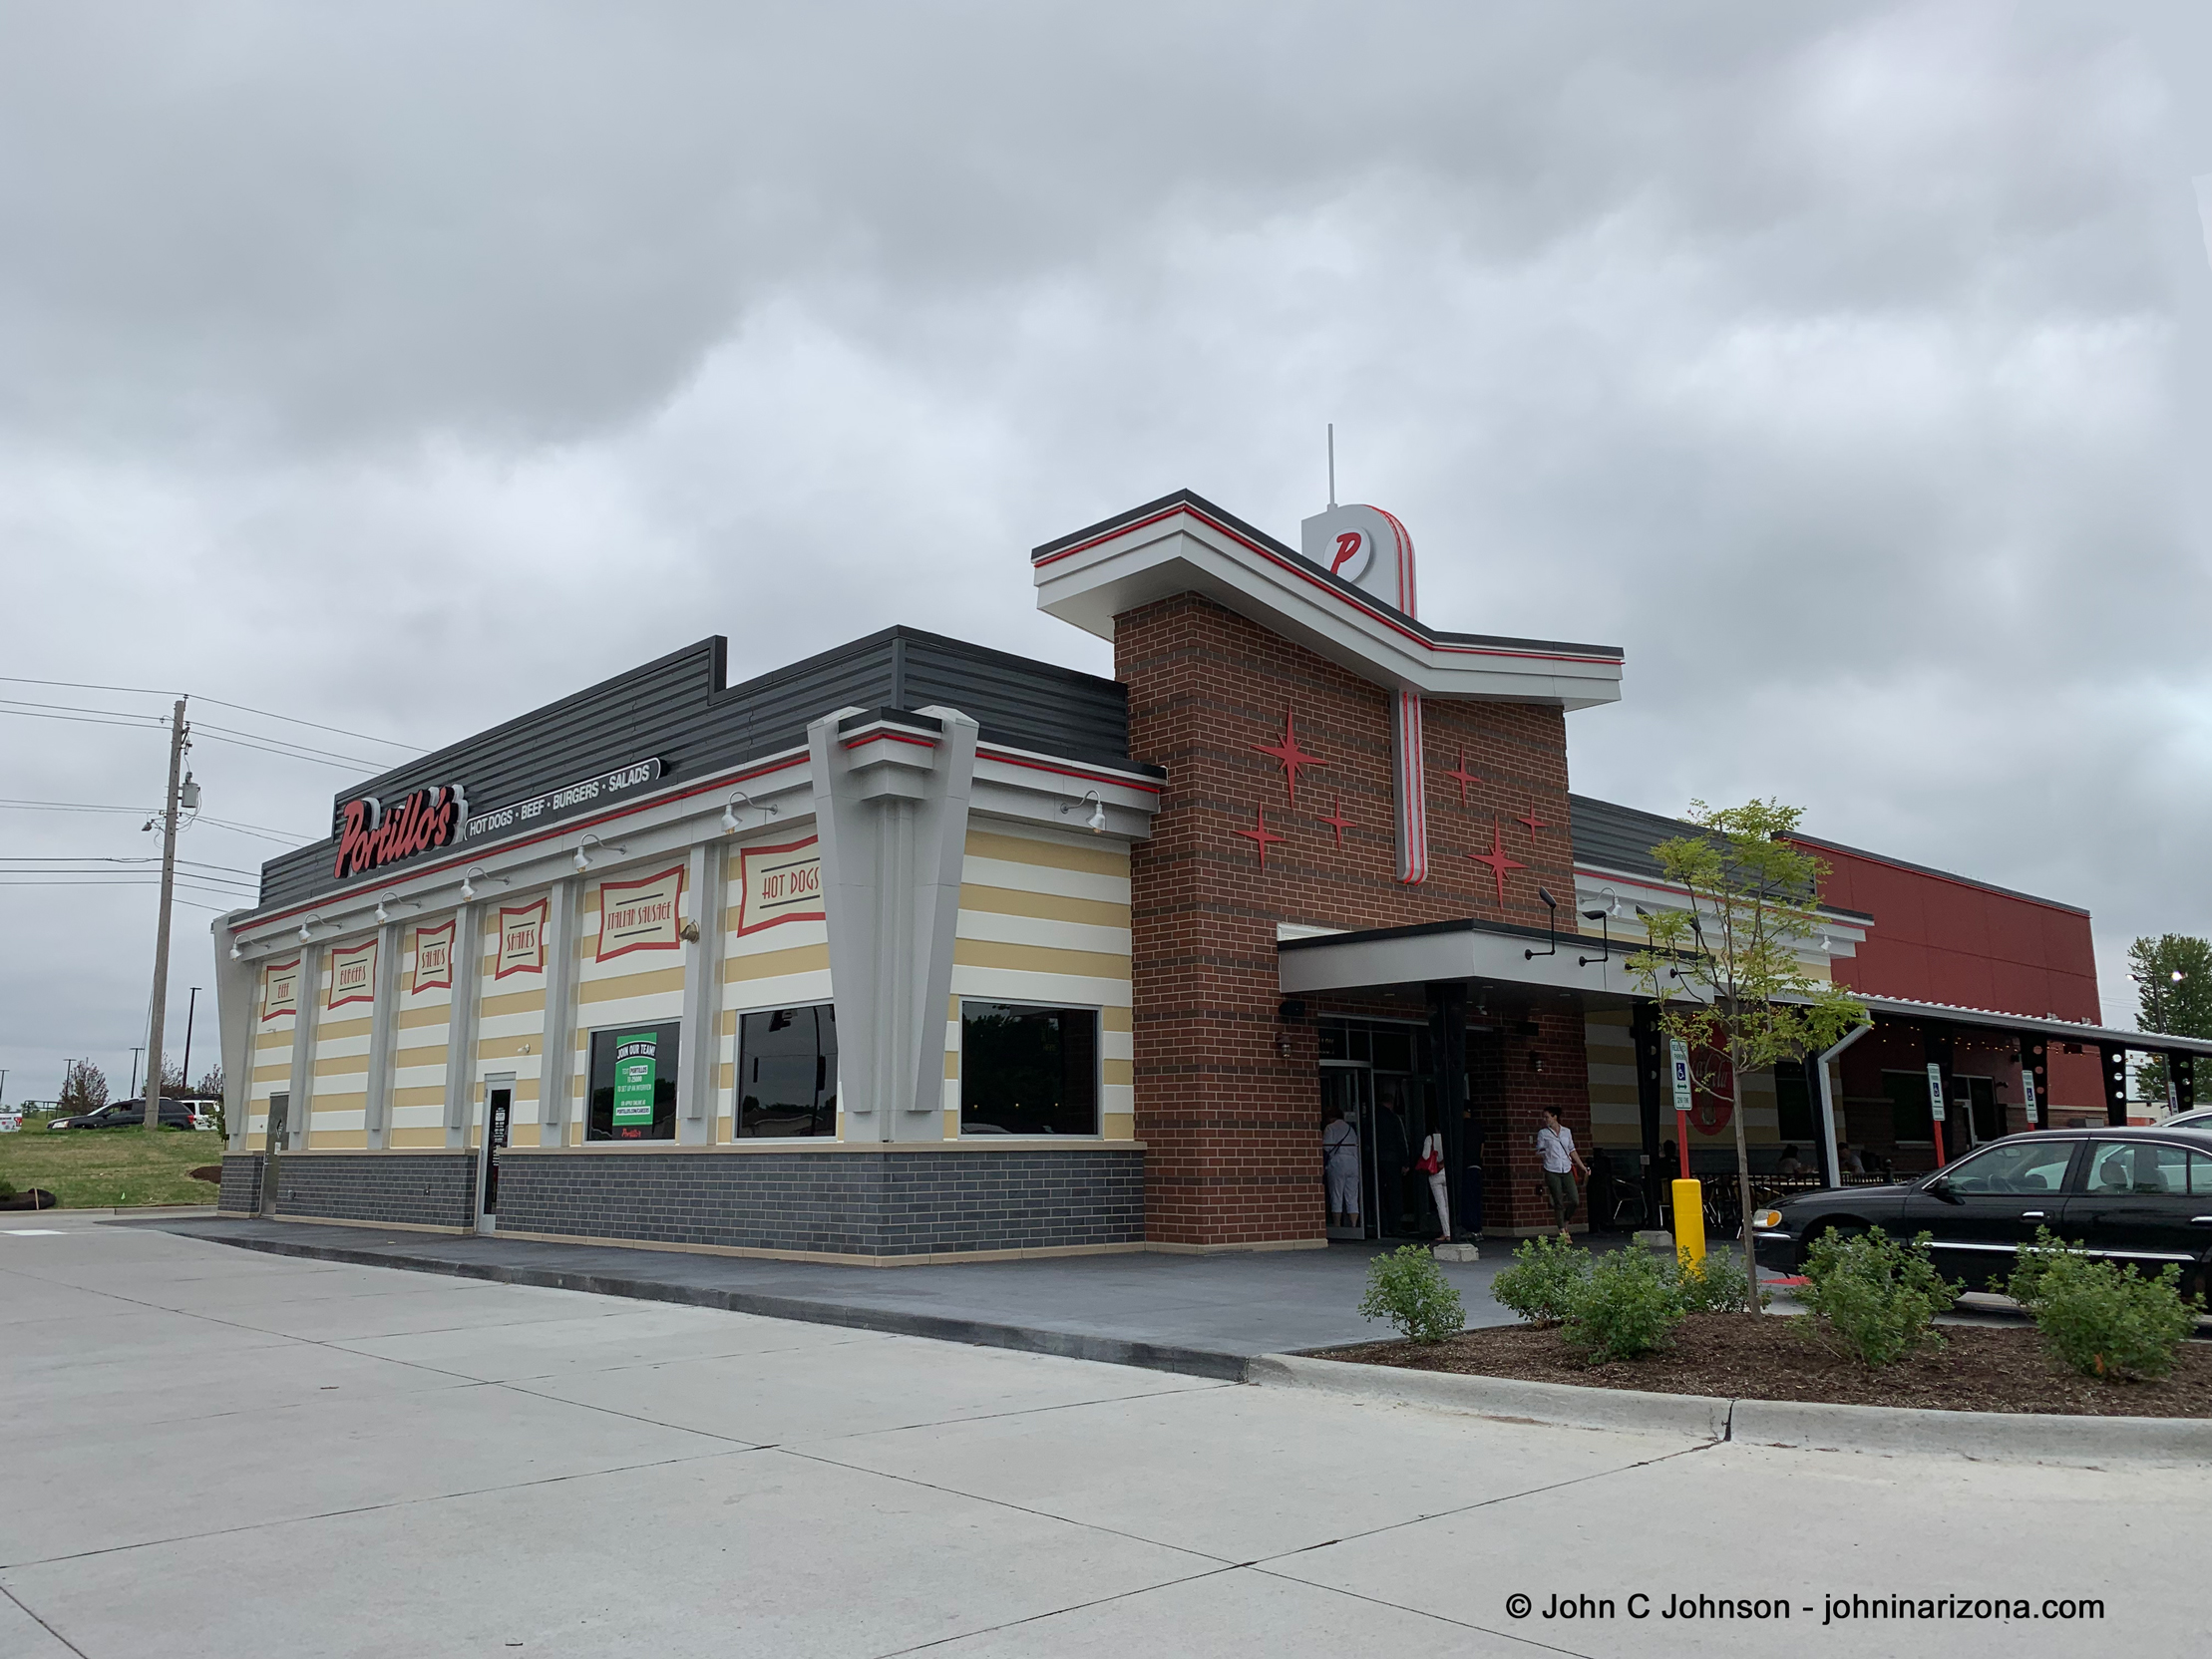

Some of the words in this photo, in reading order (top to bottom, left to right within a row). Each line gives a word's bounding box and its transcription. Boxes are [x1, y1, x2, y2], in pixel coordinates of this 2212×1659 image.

[1330, 531, 1361, 575] P
[470, 817, 489, 836] HOT
[489, 810, 513, 831] DOGS
[521, 800, 546, 821] BEEF
[553, 784, 599, 810] BURGERS
[608, 765, 650, 793] SALADS
[333, 786, 457, 878] Portillo's
[762, 874, 786, 899] HOT
[790, 866, 820, 894] DOGS
[607, 907, 635, 930] ITALIAN
[637, 901, 671, 924] SAUSAGE
[507, 929, 535, 951] SHAKES
[422, 948, 445, 968] SALADS
[340, 965, 366, 985] BURGERS
[277, 983, 289, 998] BEEF
[617, 1046, 629, 1059] JOIN
[629, 1044, 639, 1055] OUR
[640, 1044, 656, 1057] TEAM!
